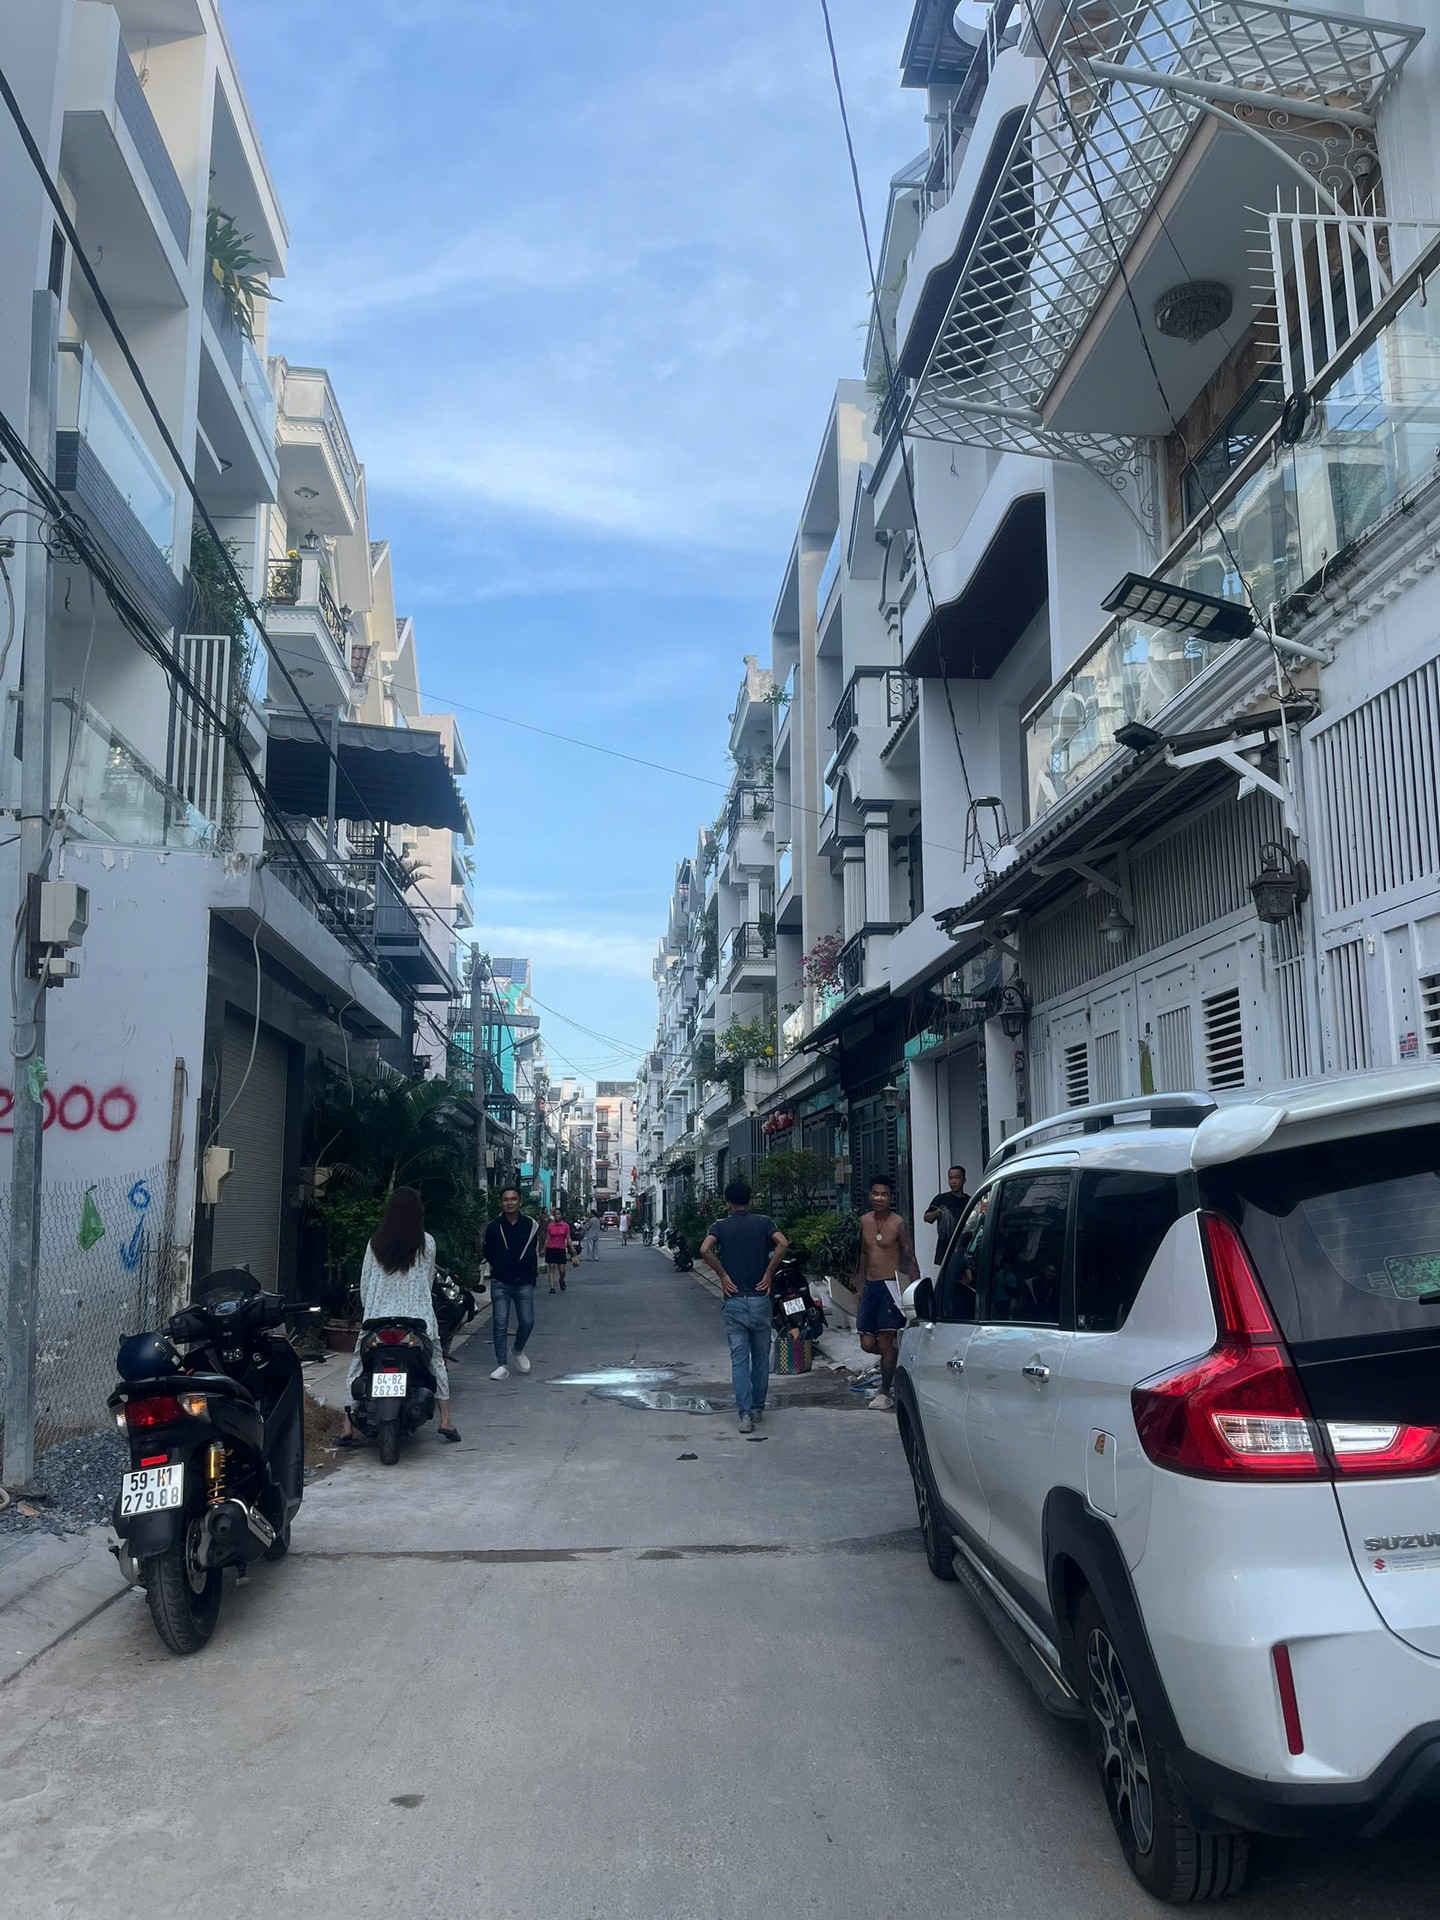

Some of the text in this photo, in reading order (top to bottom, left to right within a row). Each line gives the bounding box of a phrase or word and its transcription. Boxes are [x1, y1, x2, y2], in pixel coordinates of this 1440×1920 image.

[377, 1374, 403, 1385] 64-B2
[373, 1385, 405, 1396] 262.95
[123, 1486, 179, 1514] 279.88
[1363, 1530, 1440, 1552] SUZU
